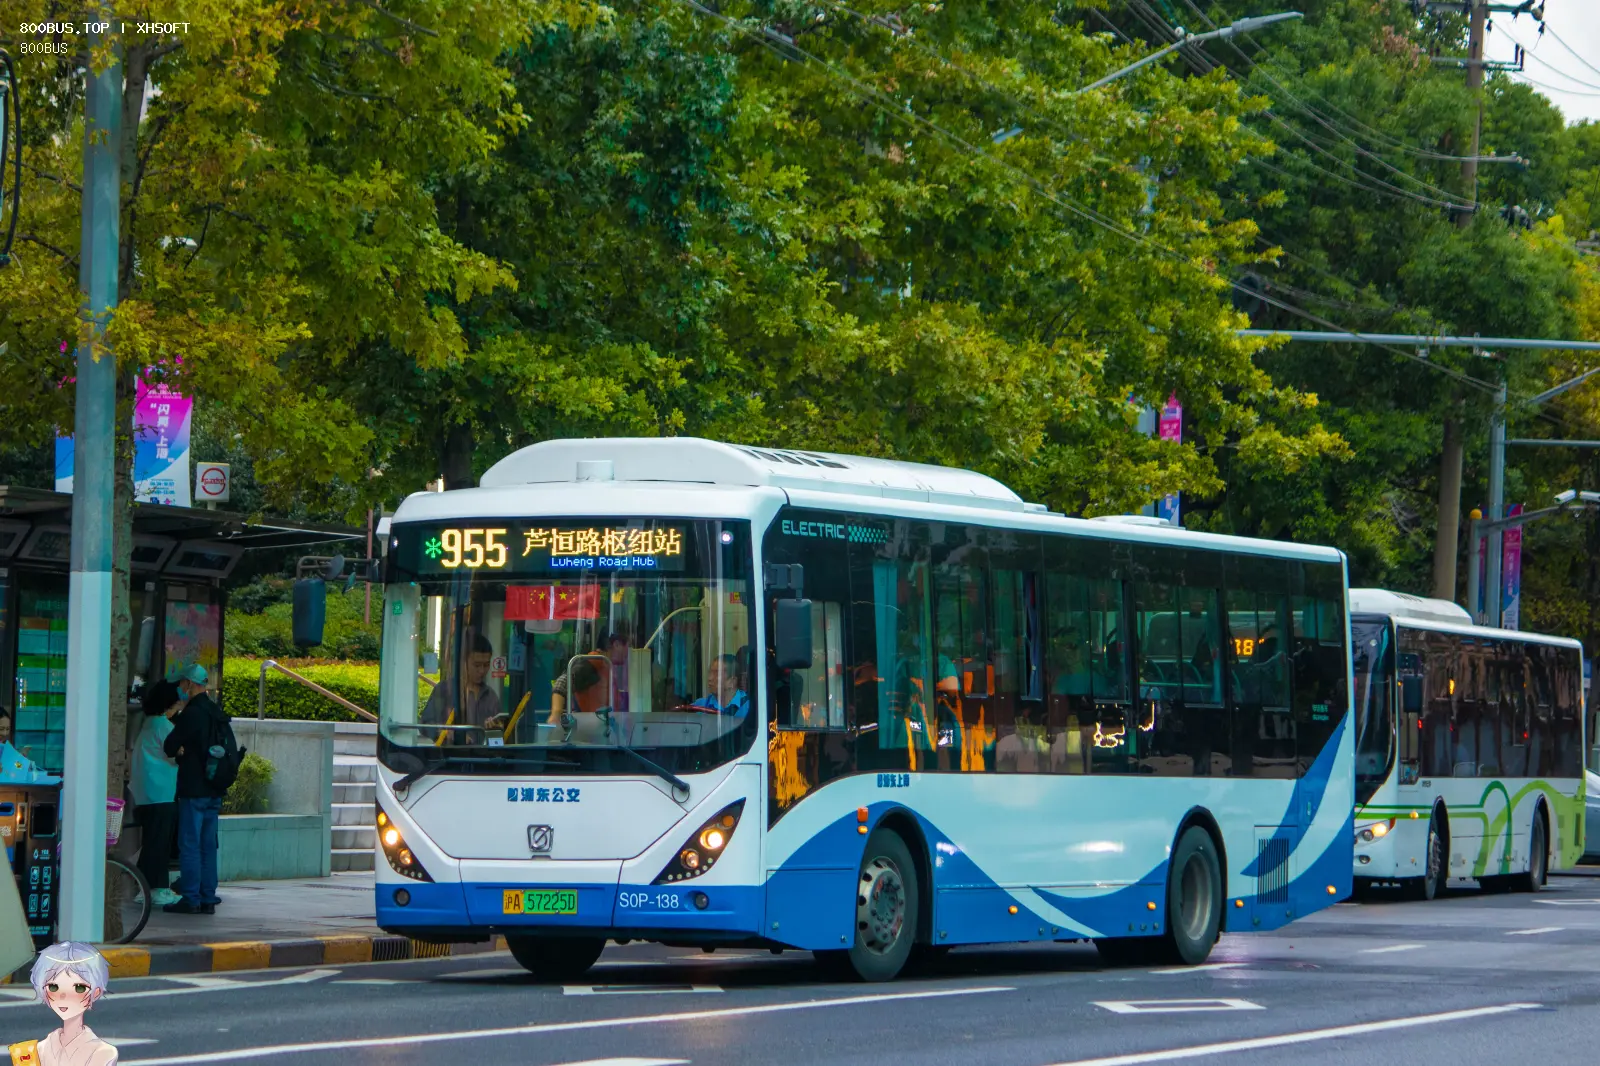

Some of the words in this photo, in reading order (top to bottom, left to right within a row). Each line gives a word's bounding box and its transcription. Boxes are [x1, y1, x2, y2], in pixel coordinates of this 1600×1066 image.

[781, 519, 846, 539] ELECTRIC
[440, 528, 508, 568] 955
[522, 527, 682, 557] 芦恒路枢纽站
[551, 556, 594, 569] Luheng
[599, 556, 628, 567] Road
[632, 556, 655, 567] Hub
[520, 786, 581, 803] 浦东公交
[527, 892, 576, 911] 57225D
